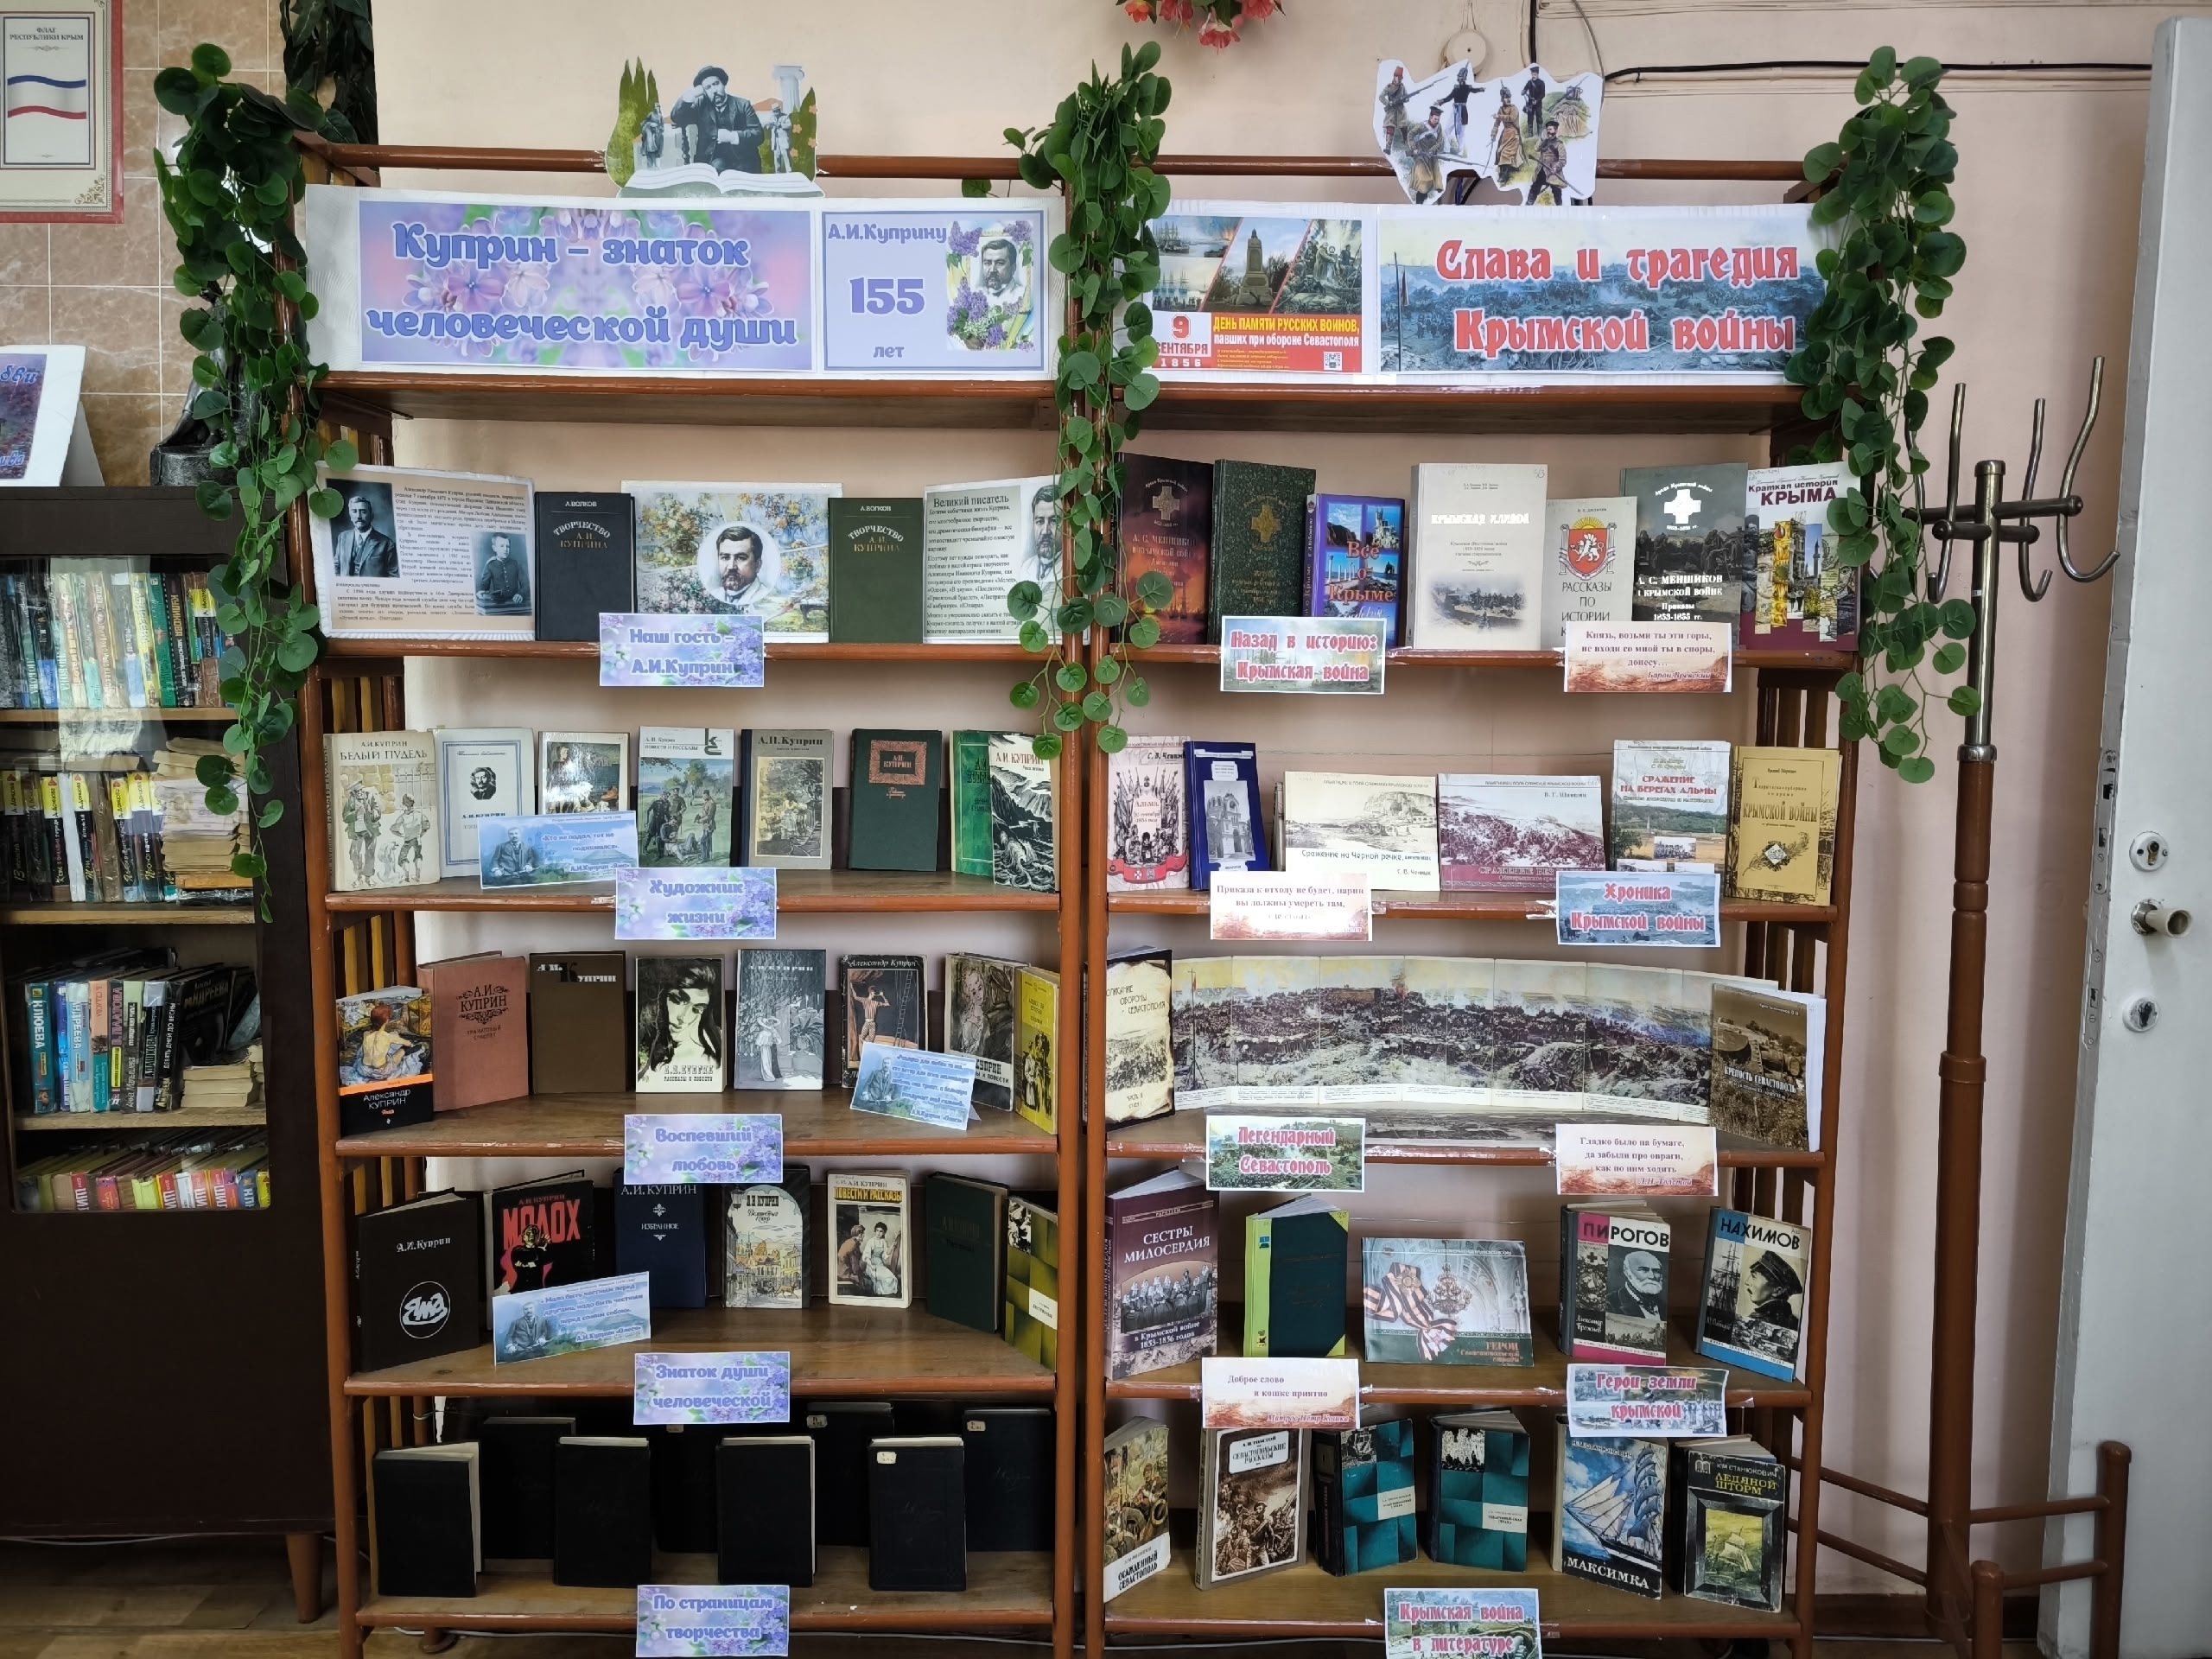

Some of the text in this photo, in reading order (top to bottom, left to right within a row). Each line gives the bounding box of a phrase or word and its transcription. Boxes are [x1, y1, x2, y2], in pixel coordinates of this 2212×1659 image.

[828, 223, 947, 244] А.И.Куприну
[393, 223, 749, 270] Куприн знаток
[1436, 240, 1798, 289] Слава и трагедия
[850, 277, 925, 315] 155
[366, 307, 798, 352] человеческой души
[1173, 315, 1191, 340] 9
[1213, 316, 1360, 334] ДЕНЬ ПАМЯТИ РУССКИХ ВОИНОВ,
[1214, 333, 1359, 348] павших при обороне Севастополя
[1454, 310, 1795, 358] Крымской войны
[873, 346, 905, 358] лет
[1749, 480, 1838, 493] Краткая история
[933, 495, 1009, 508] Великий писатель
[1760, 486, 1837, 506] КРЫМА
[553, 521, 611, 538] ТВОРЧЕСТВО
[848, 525, 904, 543] ТВОРЧЕСТВО
[1347, 541, 1380, 560] Все
[1562, 582, 1611, 593] РАССКАЗЫ
[1662, 574, 1723, 585] МЕНШИКОВ
[1329, 584, 1394, 605] Крыме
[1643, 587, 1691, 598] КРЫМСКОЙ
[1580, 597, 1596, 607] ПО
[1561, 611, 1610, 622] ИСТОРИИ
[630, 629, 721, 645] Наш гость
[1230, 631, 1377, 654] Назад в историю:
[1586, 631, 1616, 640] Князь,
[1687, 632, 1712, 641] горы,
[1684, 646, 1715, 655] споры,
[632, 659, 734, 678] А.И.Куприн
[1237, 661, 1370, 682] Крымская война
[758, 735, 823, 747] А.И.Куприн
[340, 748, 428, 761] БЕЛЫЙ ПУДЕЛЬ
[1643, 775, 1695, 784] СРАЖЕНИЕ
[1637, 785, 1676, 794] БЕРЕГАХ
[1679, 785, 1717, 795] АЛЬМЫ
[1743, 801, 1817, 823] КРЫМСКОЙ ВОЙНЫ
[1301, 849, 1338, 859] Сражение
[650, 879, 744, 897] Художник
[1217, 885, 1255, 894] Приказа
[1264, 887, 1294, 897] отходу
[1605, 883, 1671, 901] Хроника
[1287, 899, 1345, 909] умереть там,
[667, 912, 727, 924] жизни
[1571, 912, 1705, 931] Крымской войны
[849, 958, 916, 968] Александр Куприн
[474, 985, 496, 996] А.И.
[1106, 985, 1134, 997] ОПИСАНИЕ
[111, 987, 122, 1034] ПЛАТОВА
[460, 995, 507, 1013] КУПРИН
[1128, 1001, 1166, 1014] СЕВАСТОПОЛЯ
[34, 1001, 45, 1048] КЛЮЕВА
[988, 1074, 1009, 1084] ПОВЕСТИ
[1724, 1065, 1752, 1082] КРЕПОСТЬ
[1754, 1074, 1796, 1093] СЕВАСТОПОЛЬ
[364, 1089, 411, 1102] Александр
[369, 1097, 406, 1110] КУПРИН
[655, 1127, 752, 1142] Воспевший
[1238, 1126, 1336, 1147] Легендарный
[1580, 1137, 1611, 1146] Гладко
[1614, 1138, 1637, 1147] было
[1652, 1139, 1684, 1148] бумаге,
[1598, 1151, 1630, 1160] забыли
[672, 1157, 736, 1173] любовь
[1240, 1154, 1332, 1175] Севастополь
[648, 1184, 697, 1195] КУПРИН
[835, 1187, 862, 1200] ПОВЕСТИ
[869, 1189, 903, 1202] РАССКАЗЫ
[503, 1198, 581, 1251] МОЛОХ
[1143, 1226, 1193, 1245] СЕСТРЫ
[1583, 1222, 1670, 1247] ПИРОГОВ
[1720, 1217, 1801, 1250] НАХИМОВ
[396, 1236, 451, 1254] А.И.Куприн
[1124, 1236, 1211, 1263] МИЛОСЕРДИЯ
[1141, 1325, 1179, 1340] Крымской
[1179, 1322, 1200, 1332] войне
[1176, 1332, 1195, 1341] годов
[1485, 1342, 1519, 1351] ГЕРОИ
[656, 1364, 769, 1382] Знаток души
[1227, 1375, 1258, 1385] Доброе
[1597, 1372, 1697, 1392] Герои земли
[652, 1391, 772, 1408] человеческой
[1611, 1402, 1681, 1422] крымской
[1715, 1472, 1777, 1490] ЛЕДЯНОЙ
[1716, 1481, 1763, 1495] ШТОРМ
[1118, 1550, 1158, 1580] ОСАЖДЕННЫЙ
[1567, 1555, 1649, 1590] МАКСИМКА
[1119, 1562, 1158, 1591] СЕВАСТОПОЛЬ
[654, 1595, 772, 1612] По страницам
[1399, 1602, 1524, 1624] Крымская война
[665, 1627, 760, 1643] творчества
[1413, 1636, 1514, 1656] в литературе
